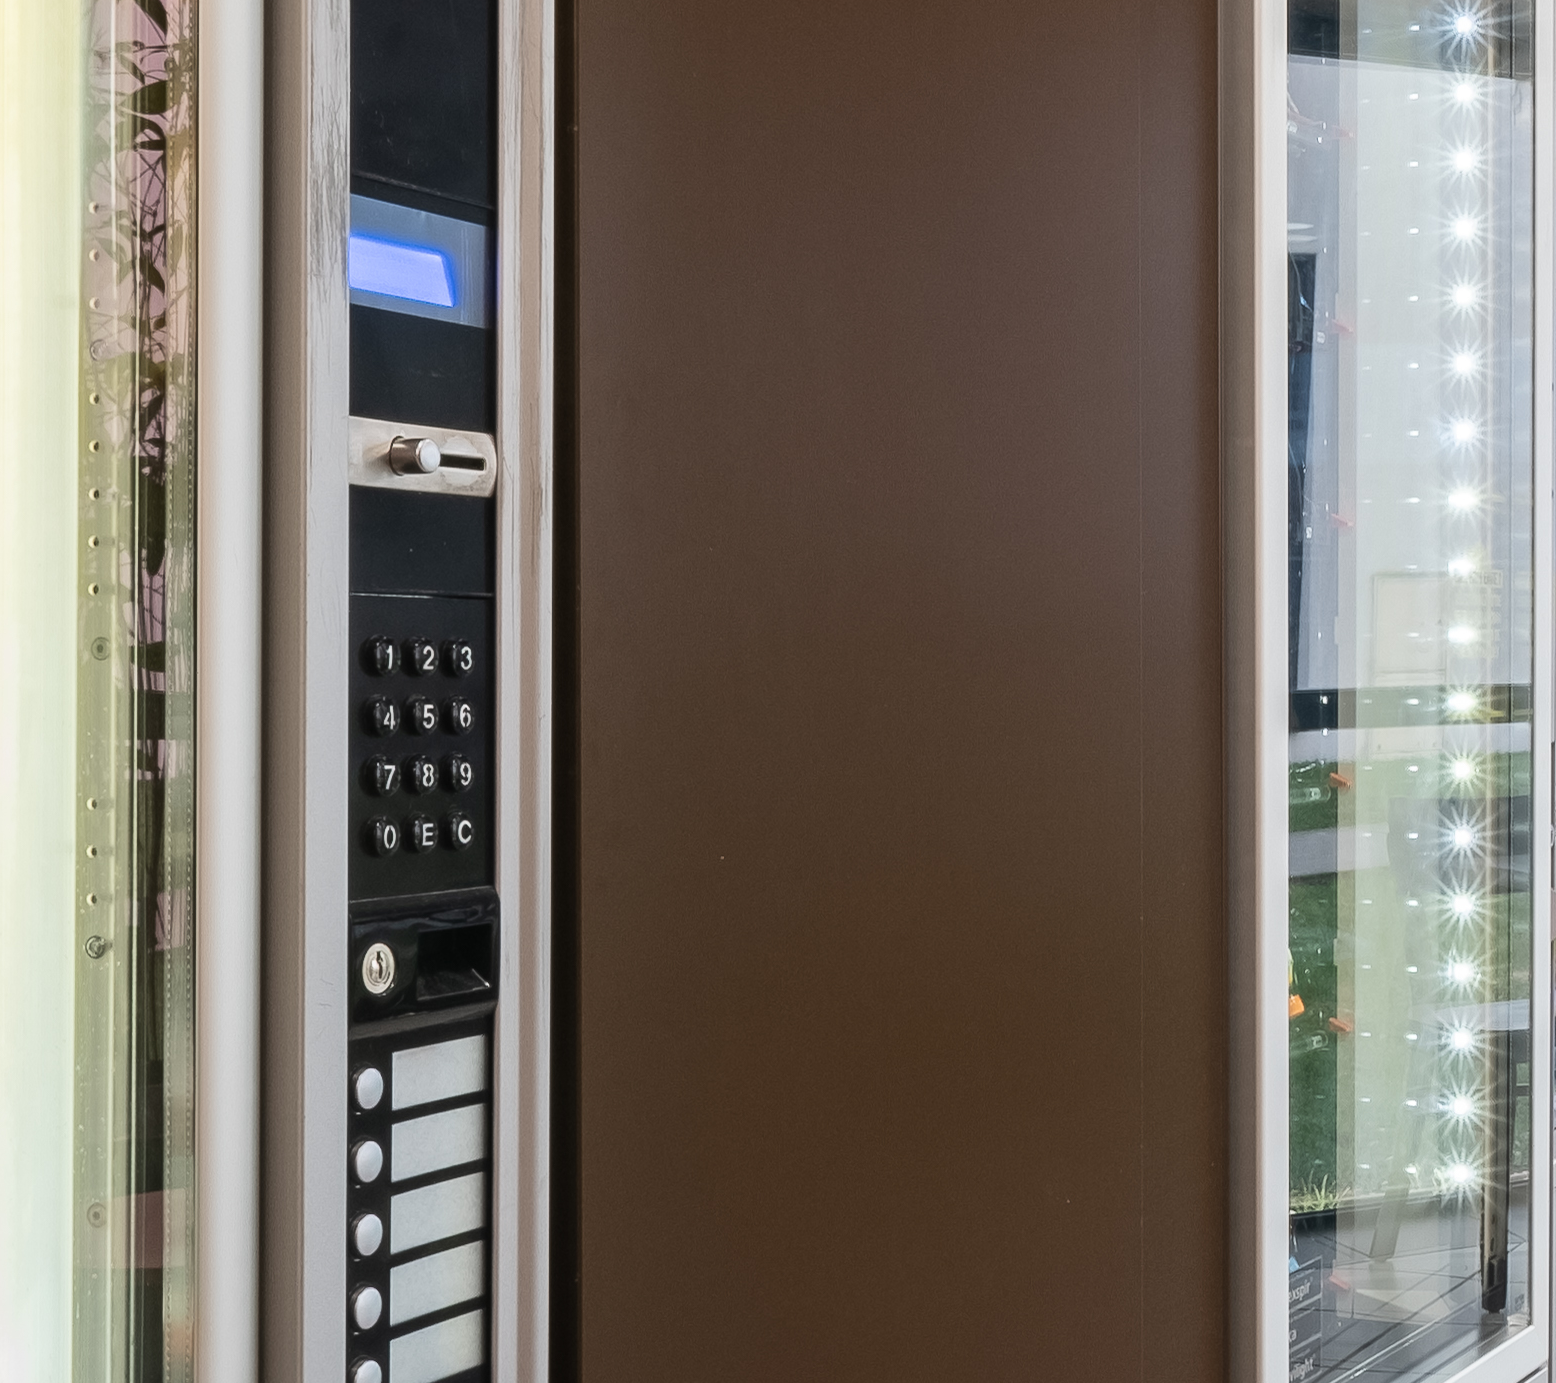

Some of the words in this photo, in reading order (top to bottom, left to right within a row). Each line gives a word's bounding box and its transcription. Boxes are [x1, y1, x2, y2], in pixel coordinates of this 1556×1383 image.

[385, 645, 394, 670] 1
[422, 645, 435, 670] 2
[460, 646, 472, 670] 3
[383, 705, 396, 730] 4
[422, 704, 435, 729] 5
[459, 704, 472, 728] 6
[383, 765, 396, 790] 7
[422, 763, 435, 787] 8
[459, 762, 472, 786] 9
[383, 824, 397, 849] 0
[422, 823, 434, 846] E
[458, 819, 472, 844] C
